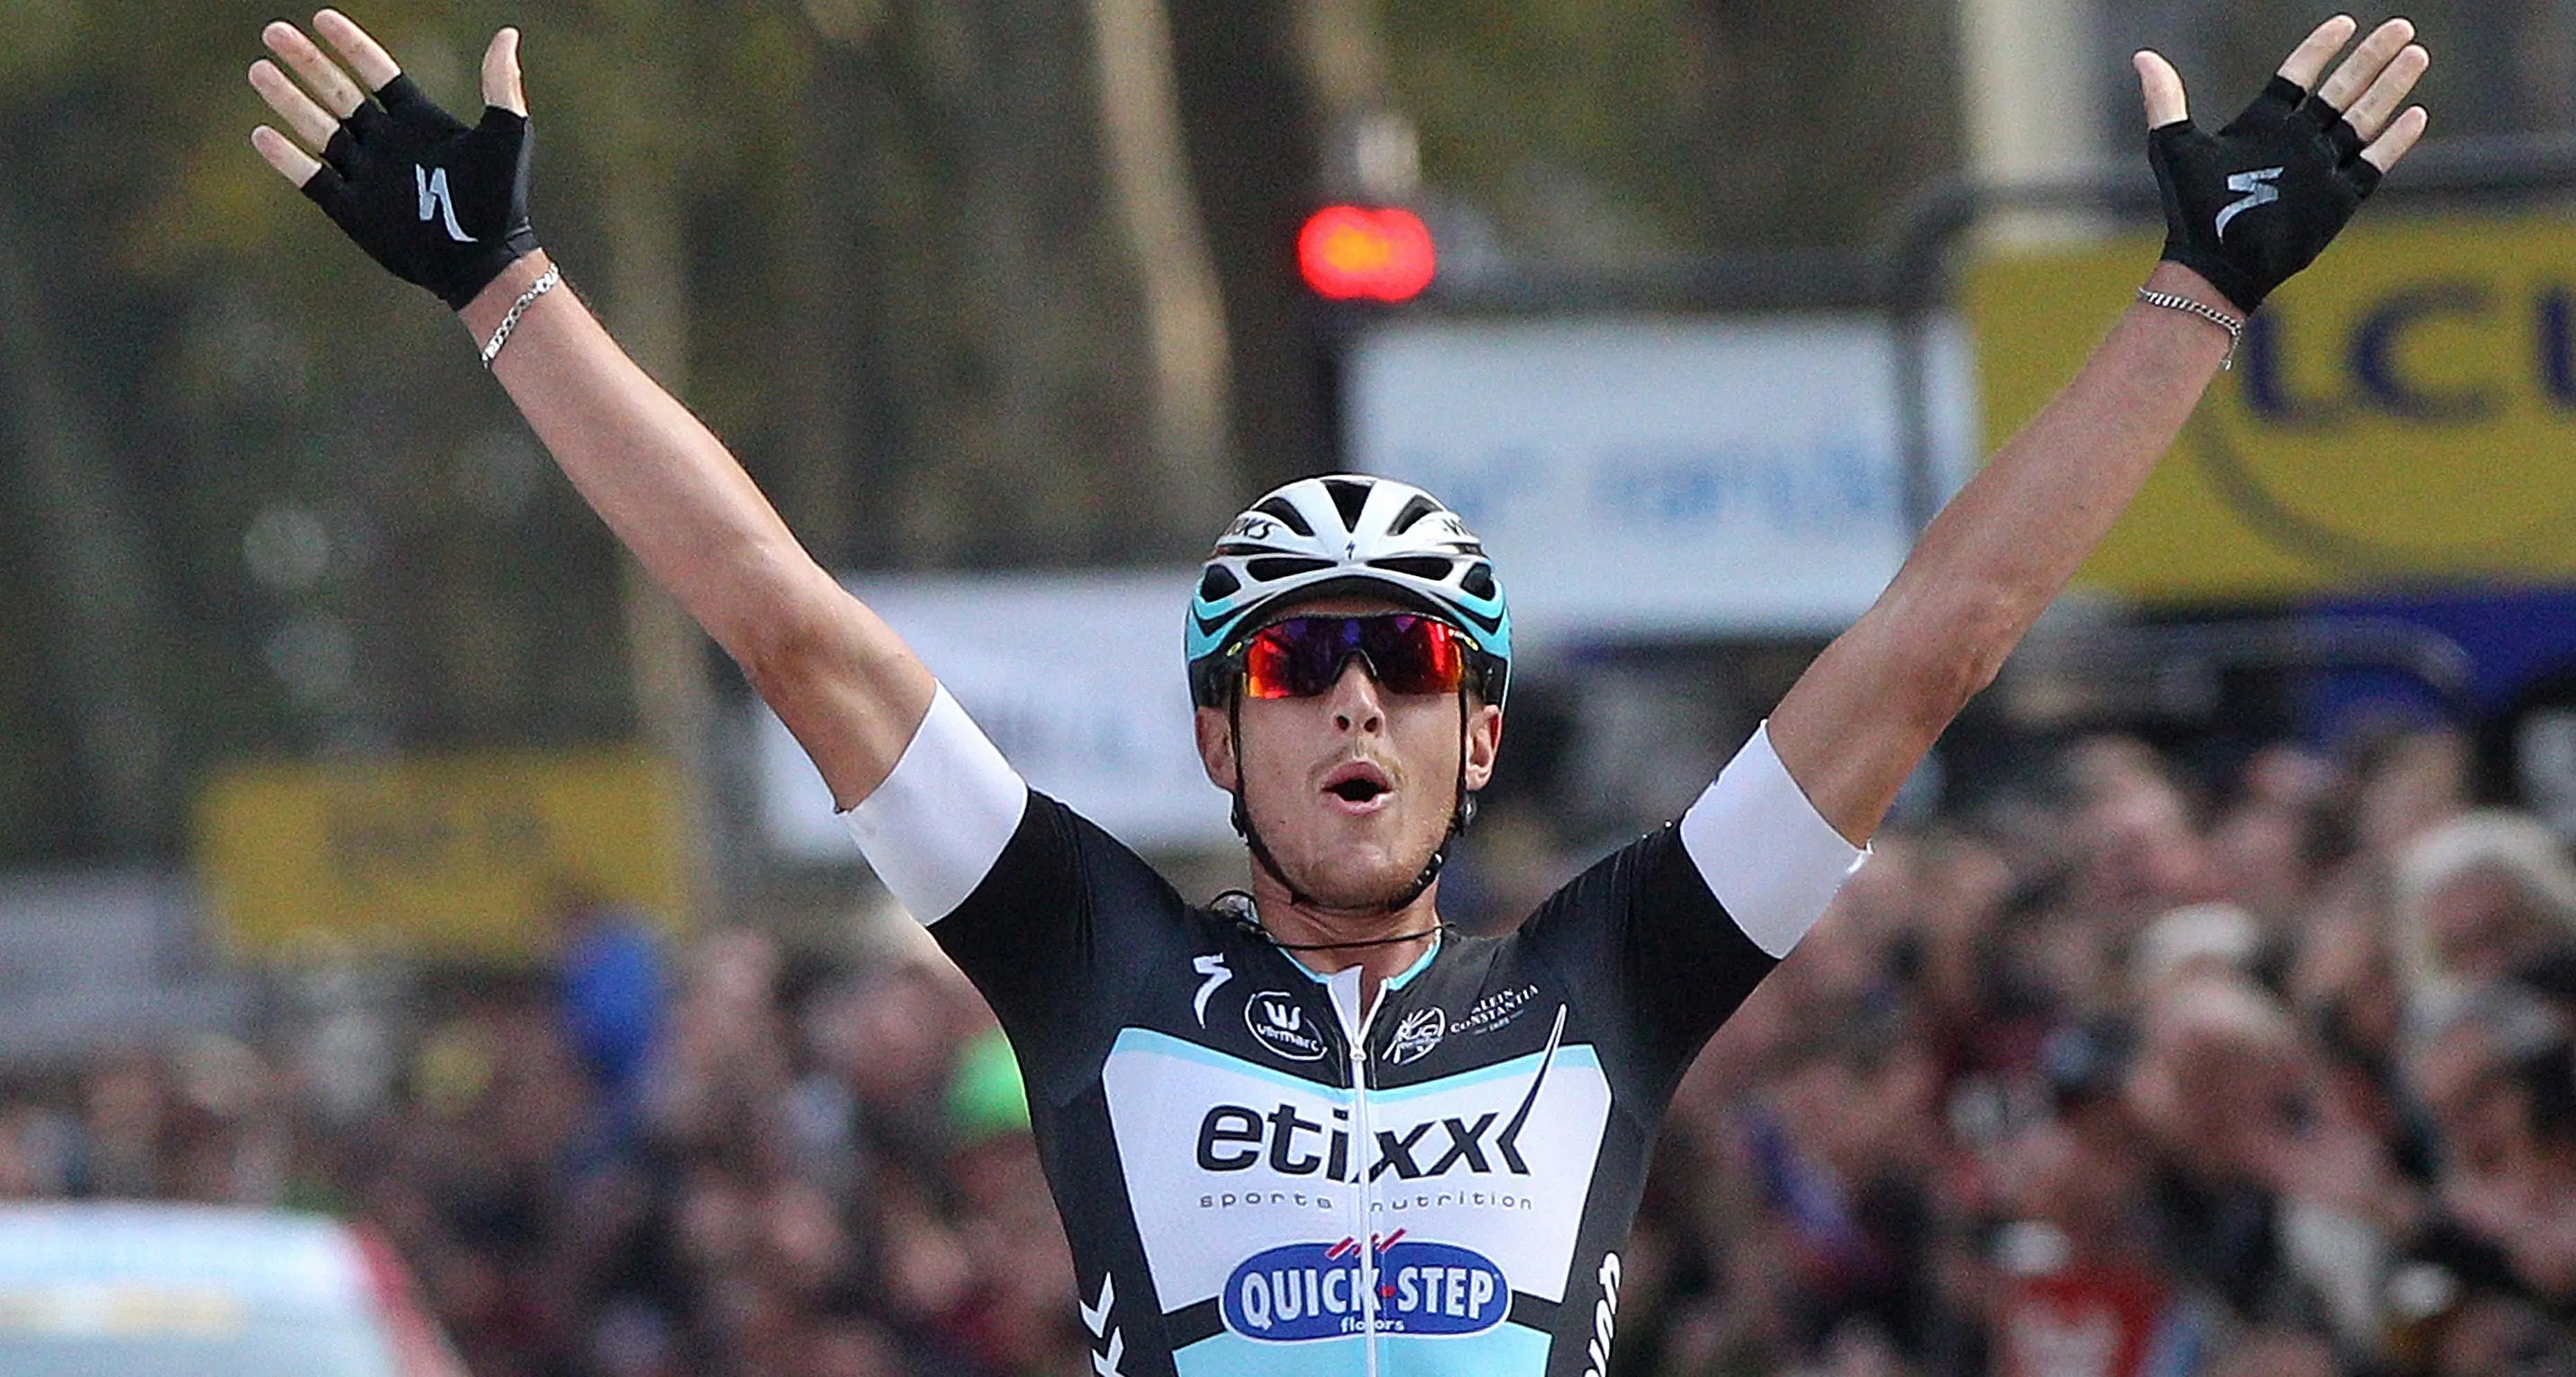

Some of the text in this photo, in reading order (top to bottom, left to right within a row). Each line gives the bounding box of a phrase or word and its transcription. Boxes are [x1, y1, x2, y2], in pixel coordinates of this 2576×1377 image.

[1197, 1103, 1500, 1184] etixx
[1199, 1190, 1532, 1212] sports nutrition
[1341, 1316, 1405, 1333] floors
